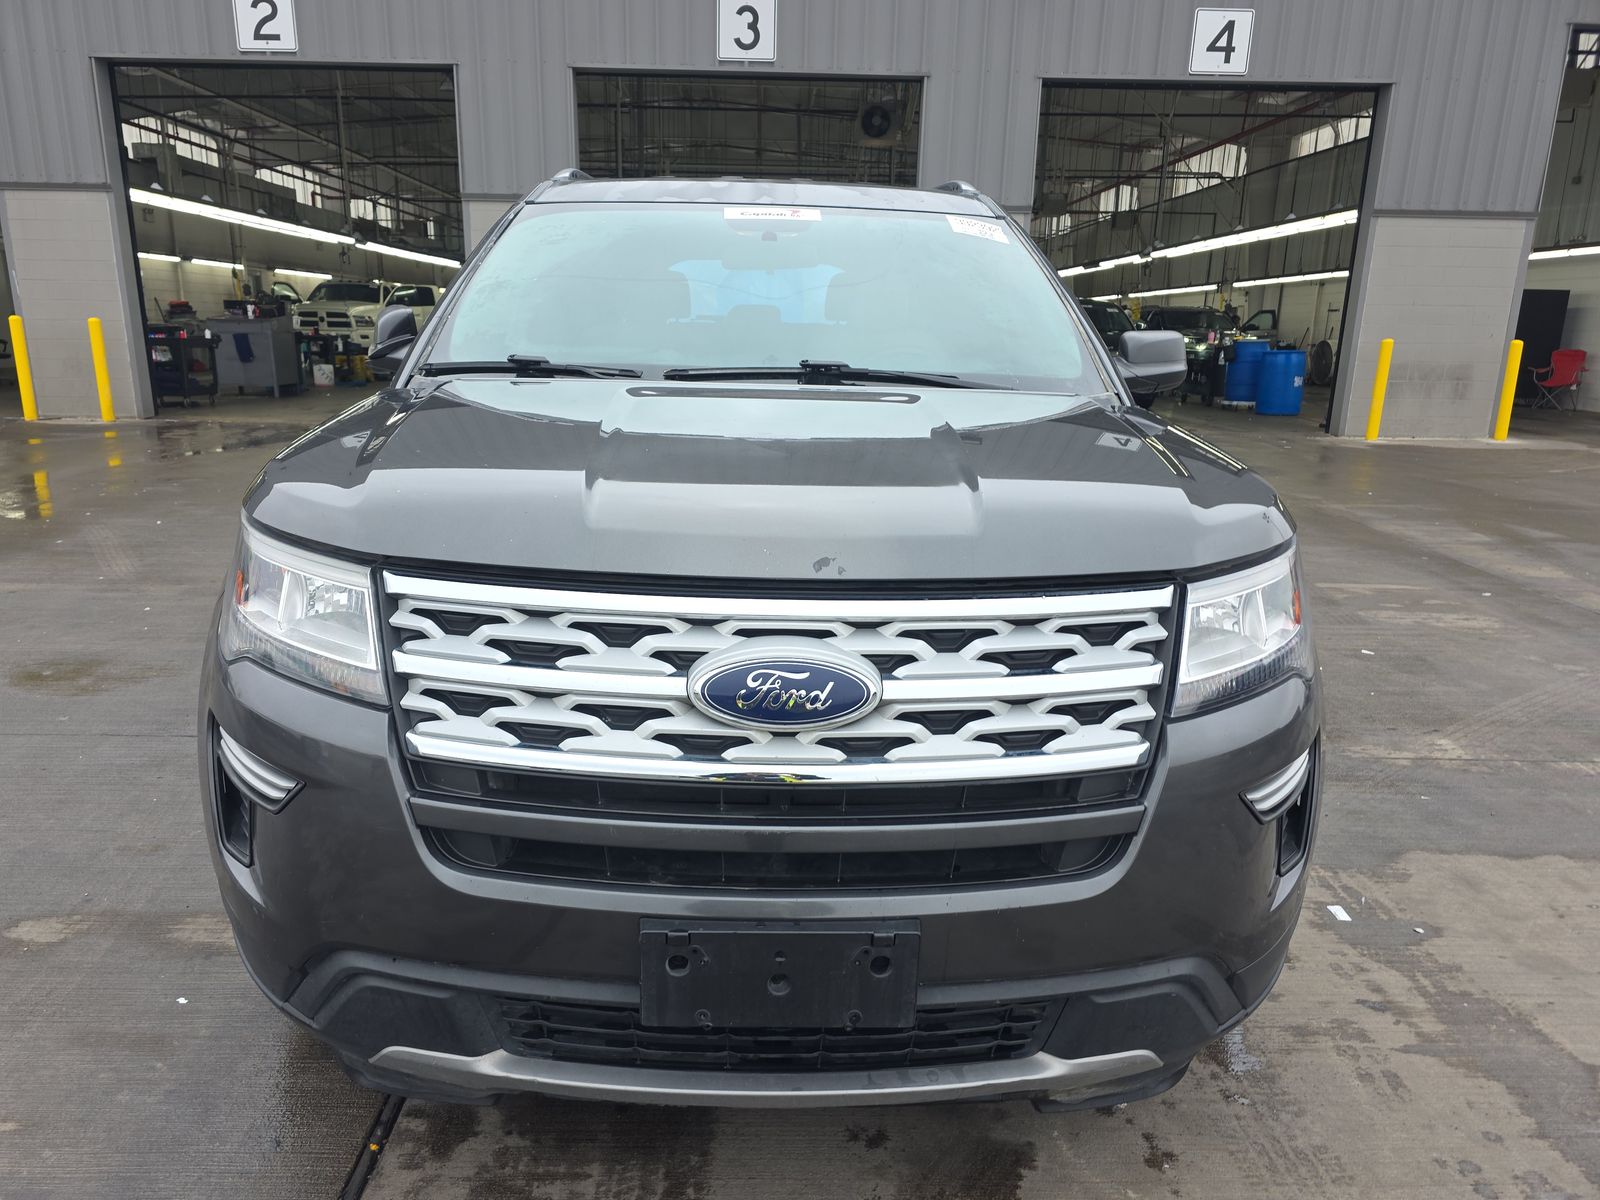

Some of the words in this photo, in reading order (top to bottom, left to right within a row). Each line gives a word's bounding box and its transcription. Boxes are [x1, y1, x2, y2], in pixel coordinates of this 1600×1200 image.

[251, 0, 280, 41] 2
[733, 4, 760, 51] 3
[1206, 19, 1236, 64] 4
[736, 669, 834, 710] Ford
